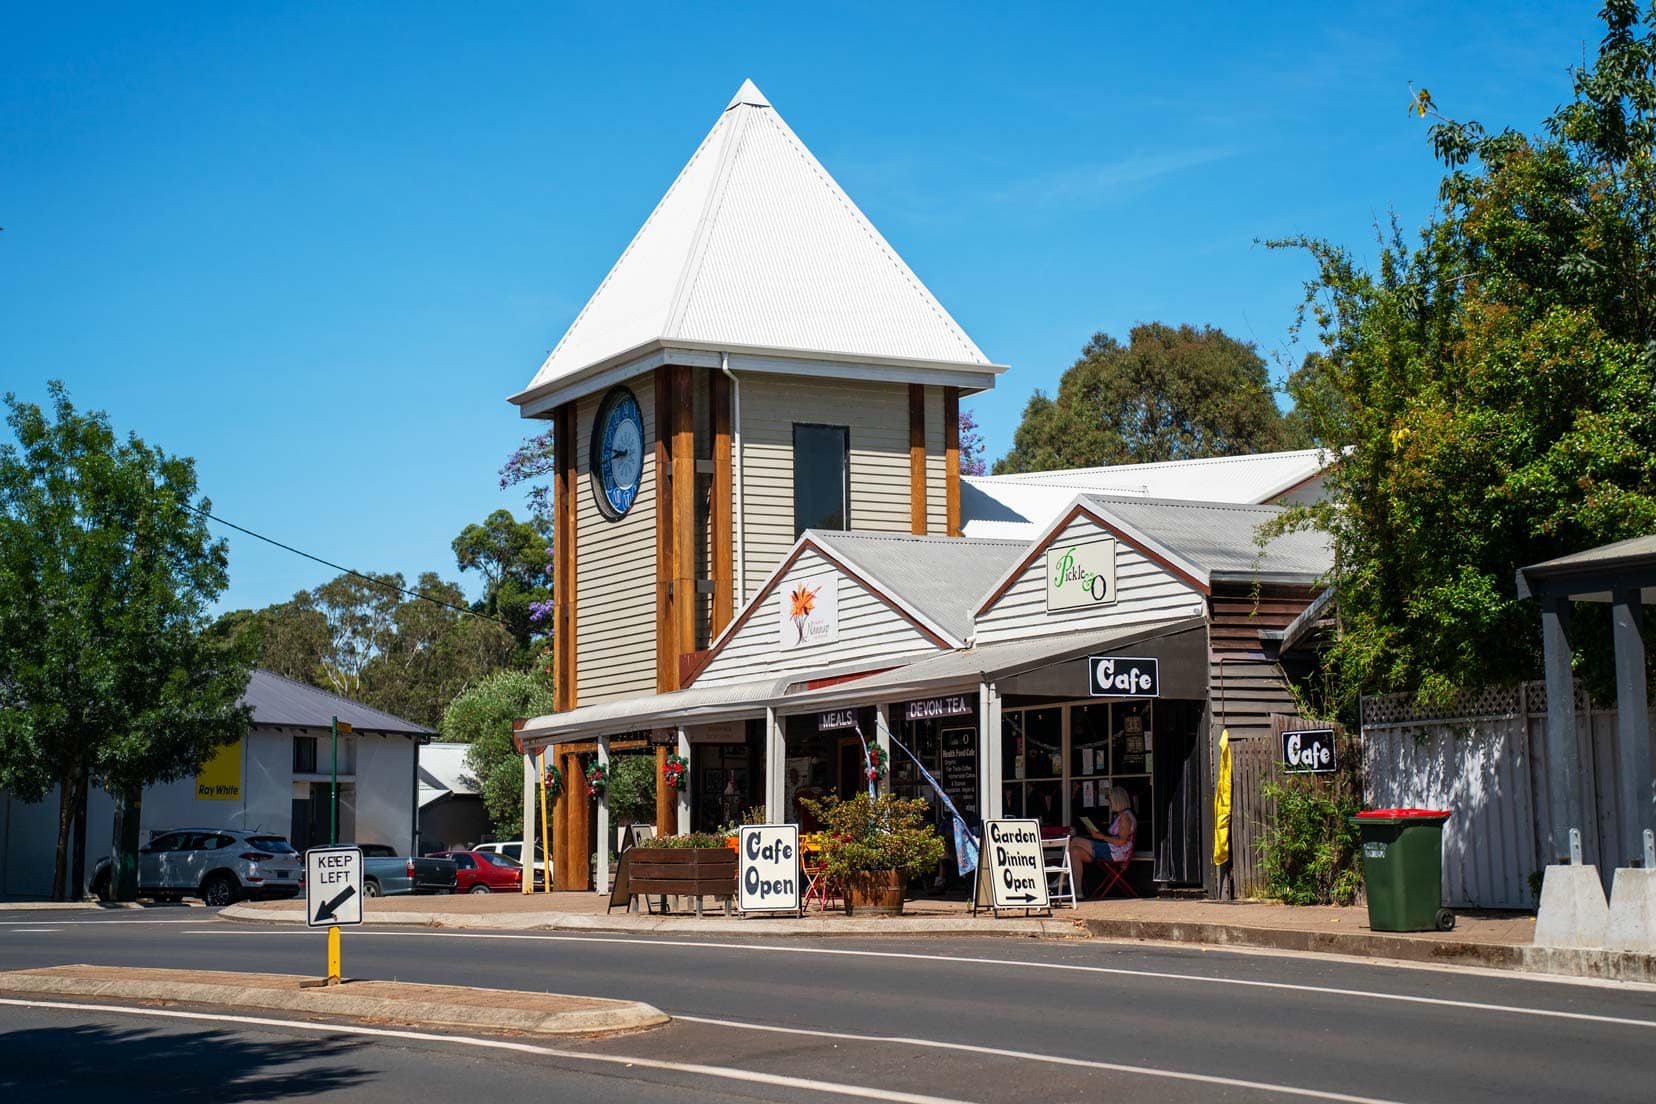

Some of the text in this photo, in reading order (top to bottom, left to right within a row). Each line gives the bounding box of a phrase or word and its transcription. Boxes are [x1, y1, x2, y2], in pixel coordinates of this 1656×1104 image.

[1054, 547, 1085, 588] Pickle
[1091, 574, 1107, 601] O
[1096, 659, 1152, 694] Cafe
[910, 696, 966, 718] DEVON TEA
[822, 710, 853, 729] MEALS
[1287, 734, 1330, 769] Cafe
[198, 784, 239, 797] Ray White
[991, 823, 1037, 844] Garden
[746, 831, 793, 865] Cafe
[996, 846, 1037, 869] Dining
[318, 855, 353, 869] KEEP
[320, 870, 351, 884] LEFT
[744, 866, 794, 899] Open
[1003, 868, 1036, 892] Open
